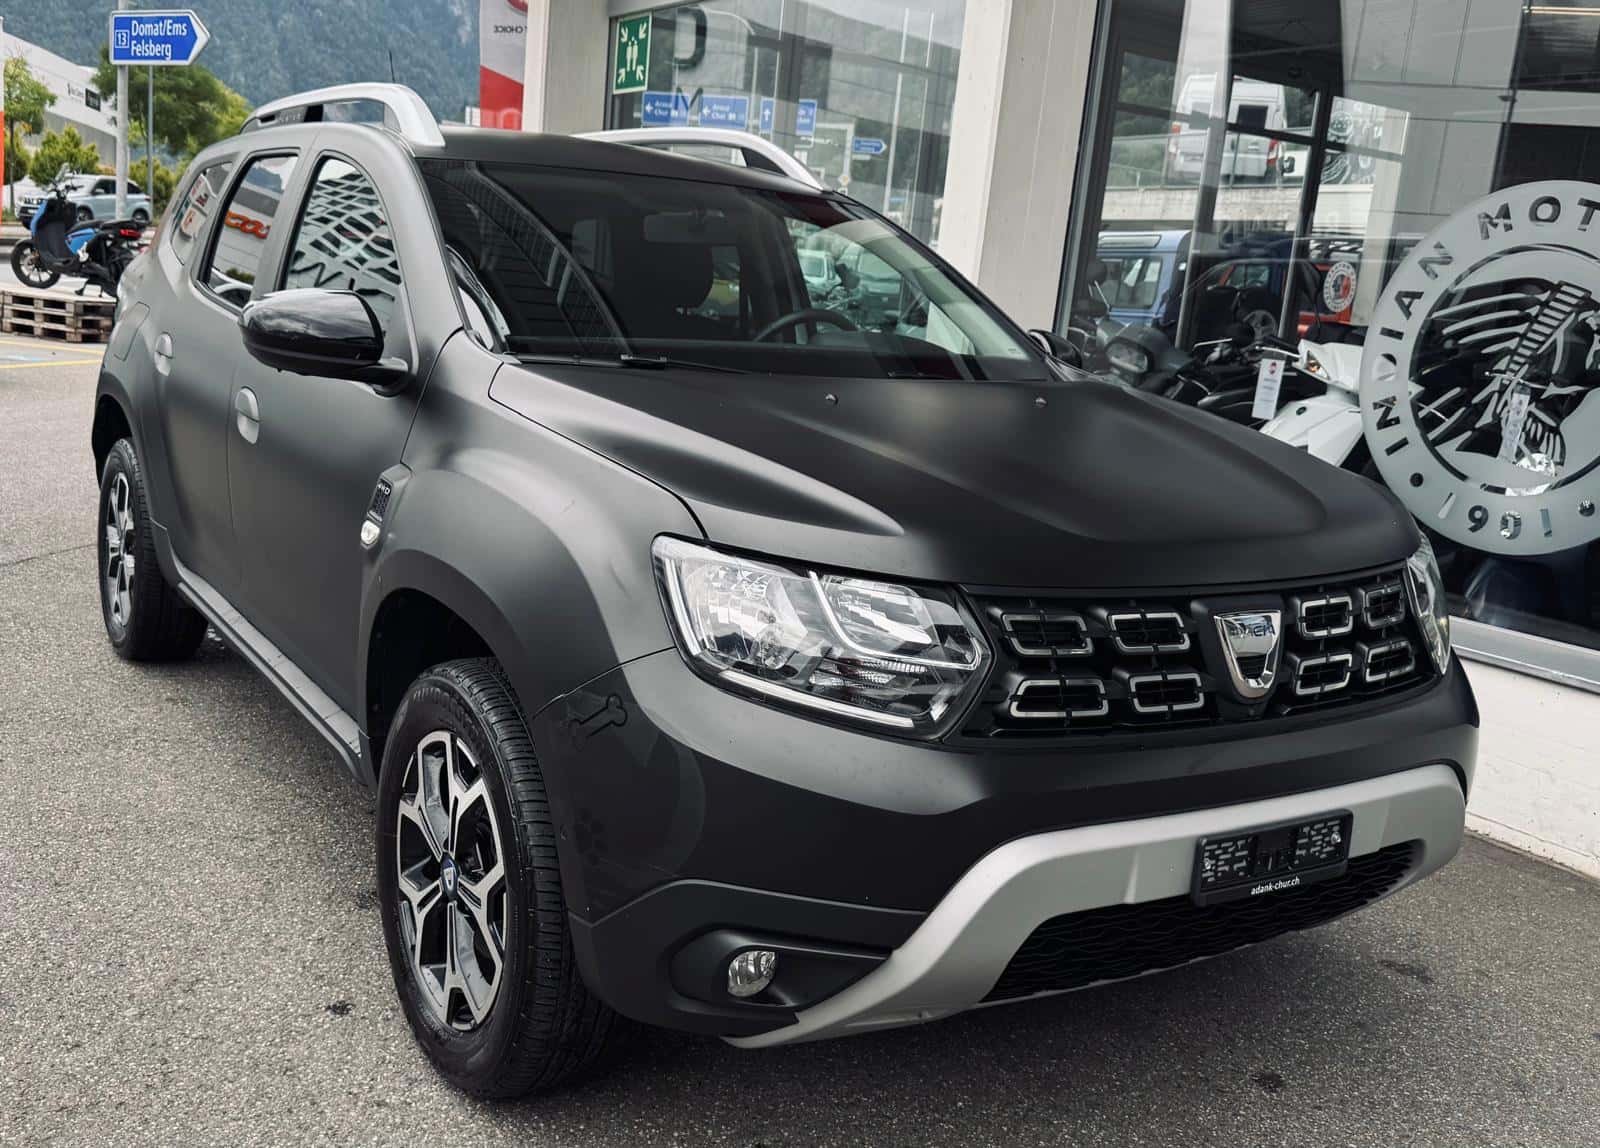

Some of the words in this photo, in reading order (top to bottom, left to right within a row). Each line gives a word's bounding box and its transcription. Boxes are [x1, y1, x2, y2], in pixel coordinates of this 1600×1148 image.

[131, 19, 188, 37] Domat/Ems
[117, 32, 128, 48] 13
[131, 39, 172, 60] Felsberg
[1373, 241, 1454, 456] INDIAN
[1438, 491, 1553, 540] 1901
[1250, 875, 1300, 895] adank-chur.ch
